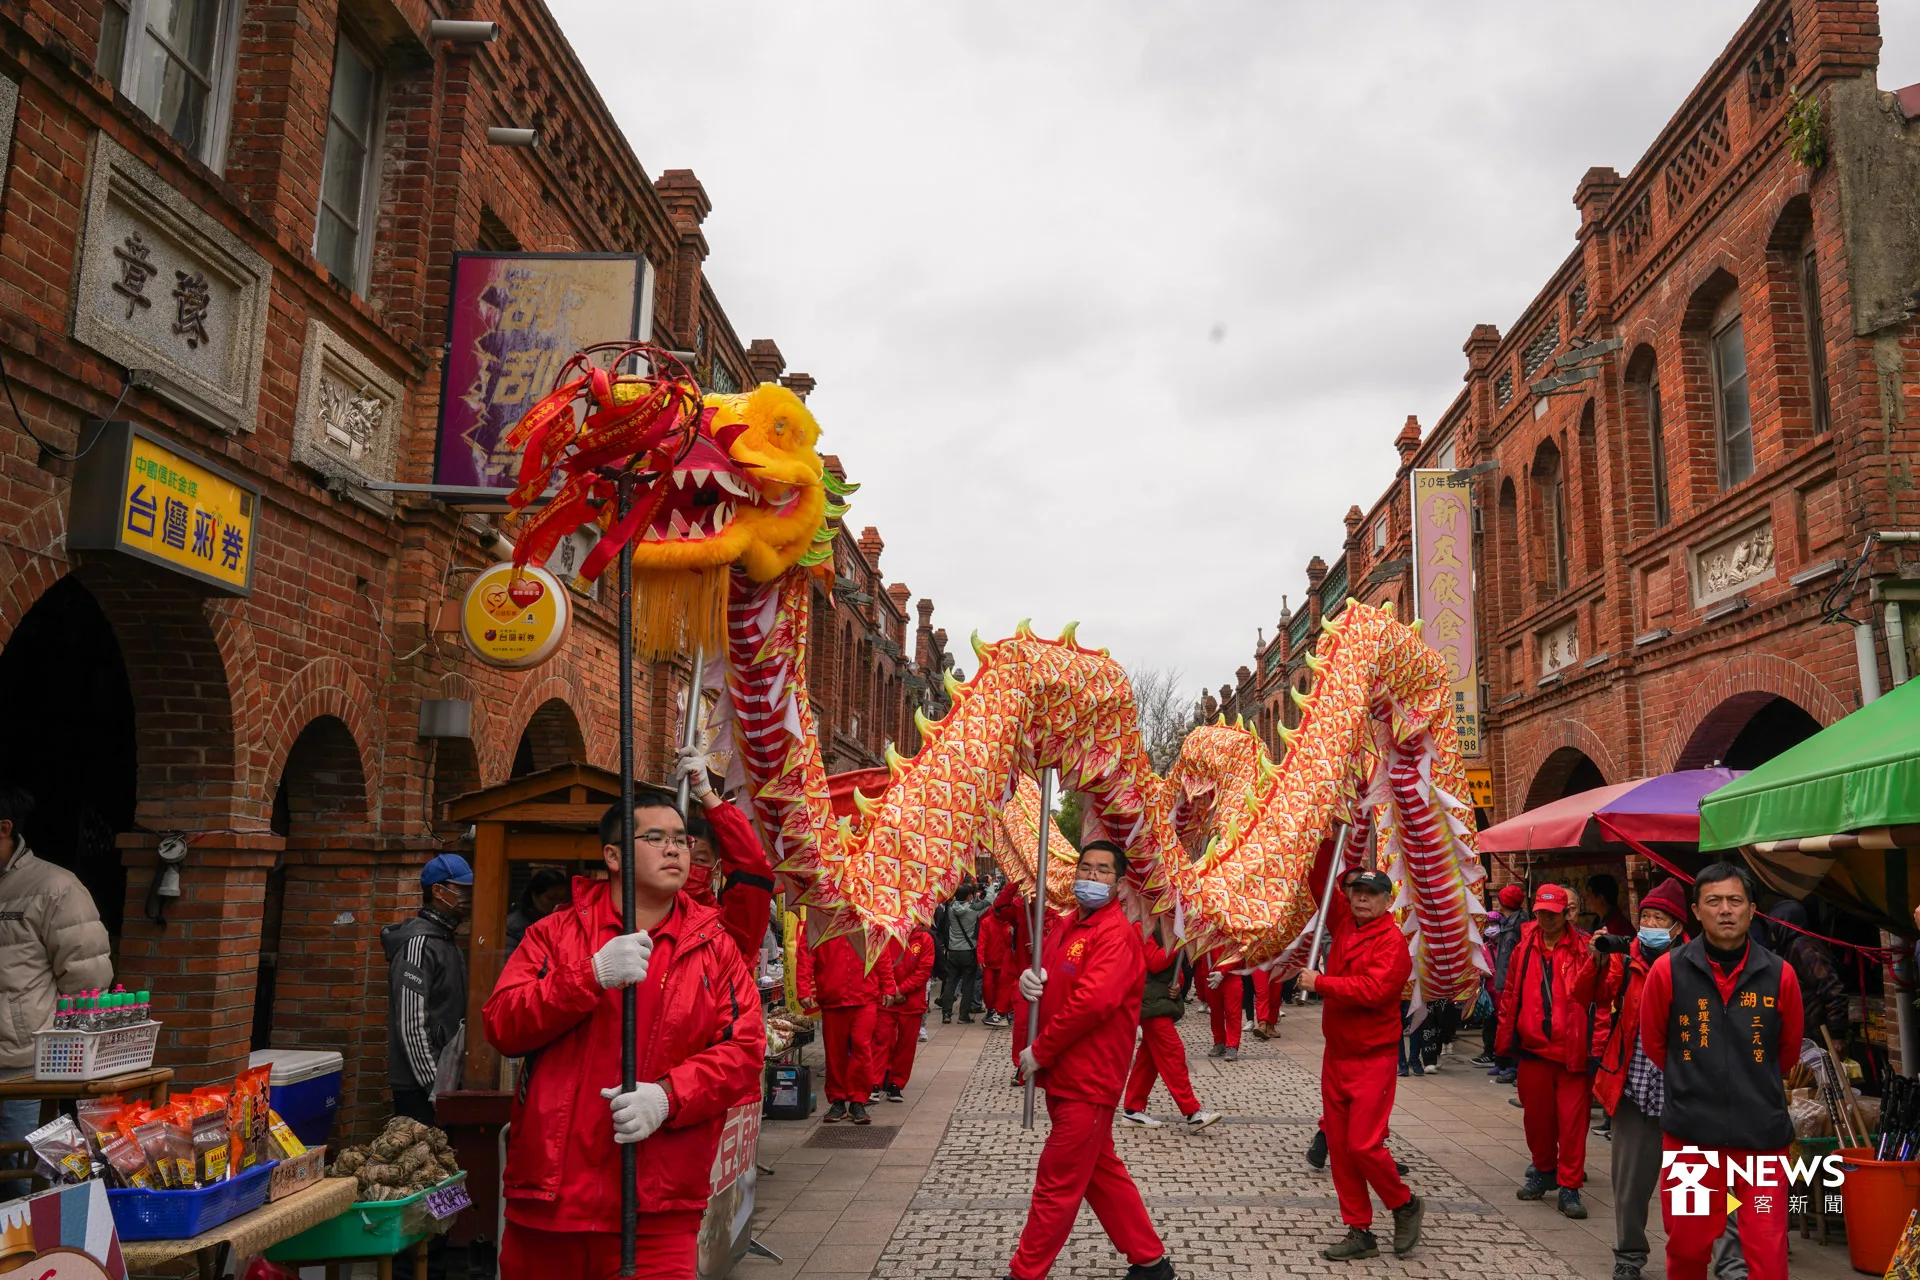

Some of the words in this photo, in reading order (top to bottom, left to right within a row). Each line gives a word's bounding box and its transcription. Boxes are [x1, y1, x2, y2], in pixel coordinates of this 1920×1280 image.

[135, 456, 198, 499] 中國信託金控
[127, 484, 244, 571] 台灣彩券
[1698, 998, 1710, 1048] 管理委員
[1740, 991, 1775, 1008] 湖口
[1751, 1016, 1764, 1063] 三元宮
